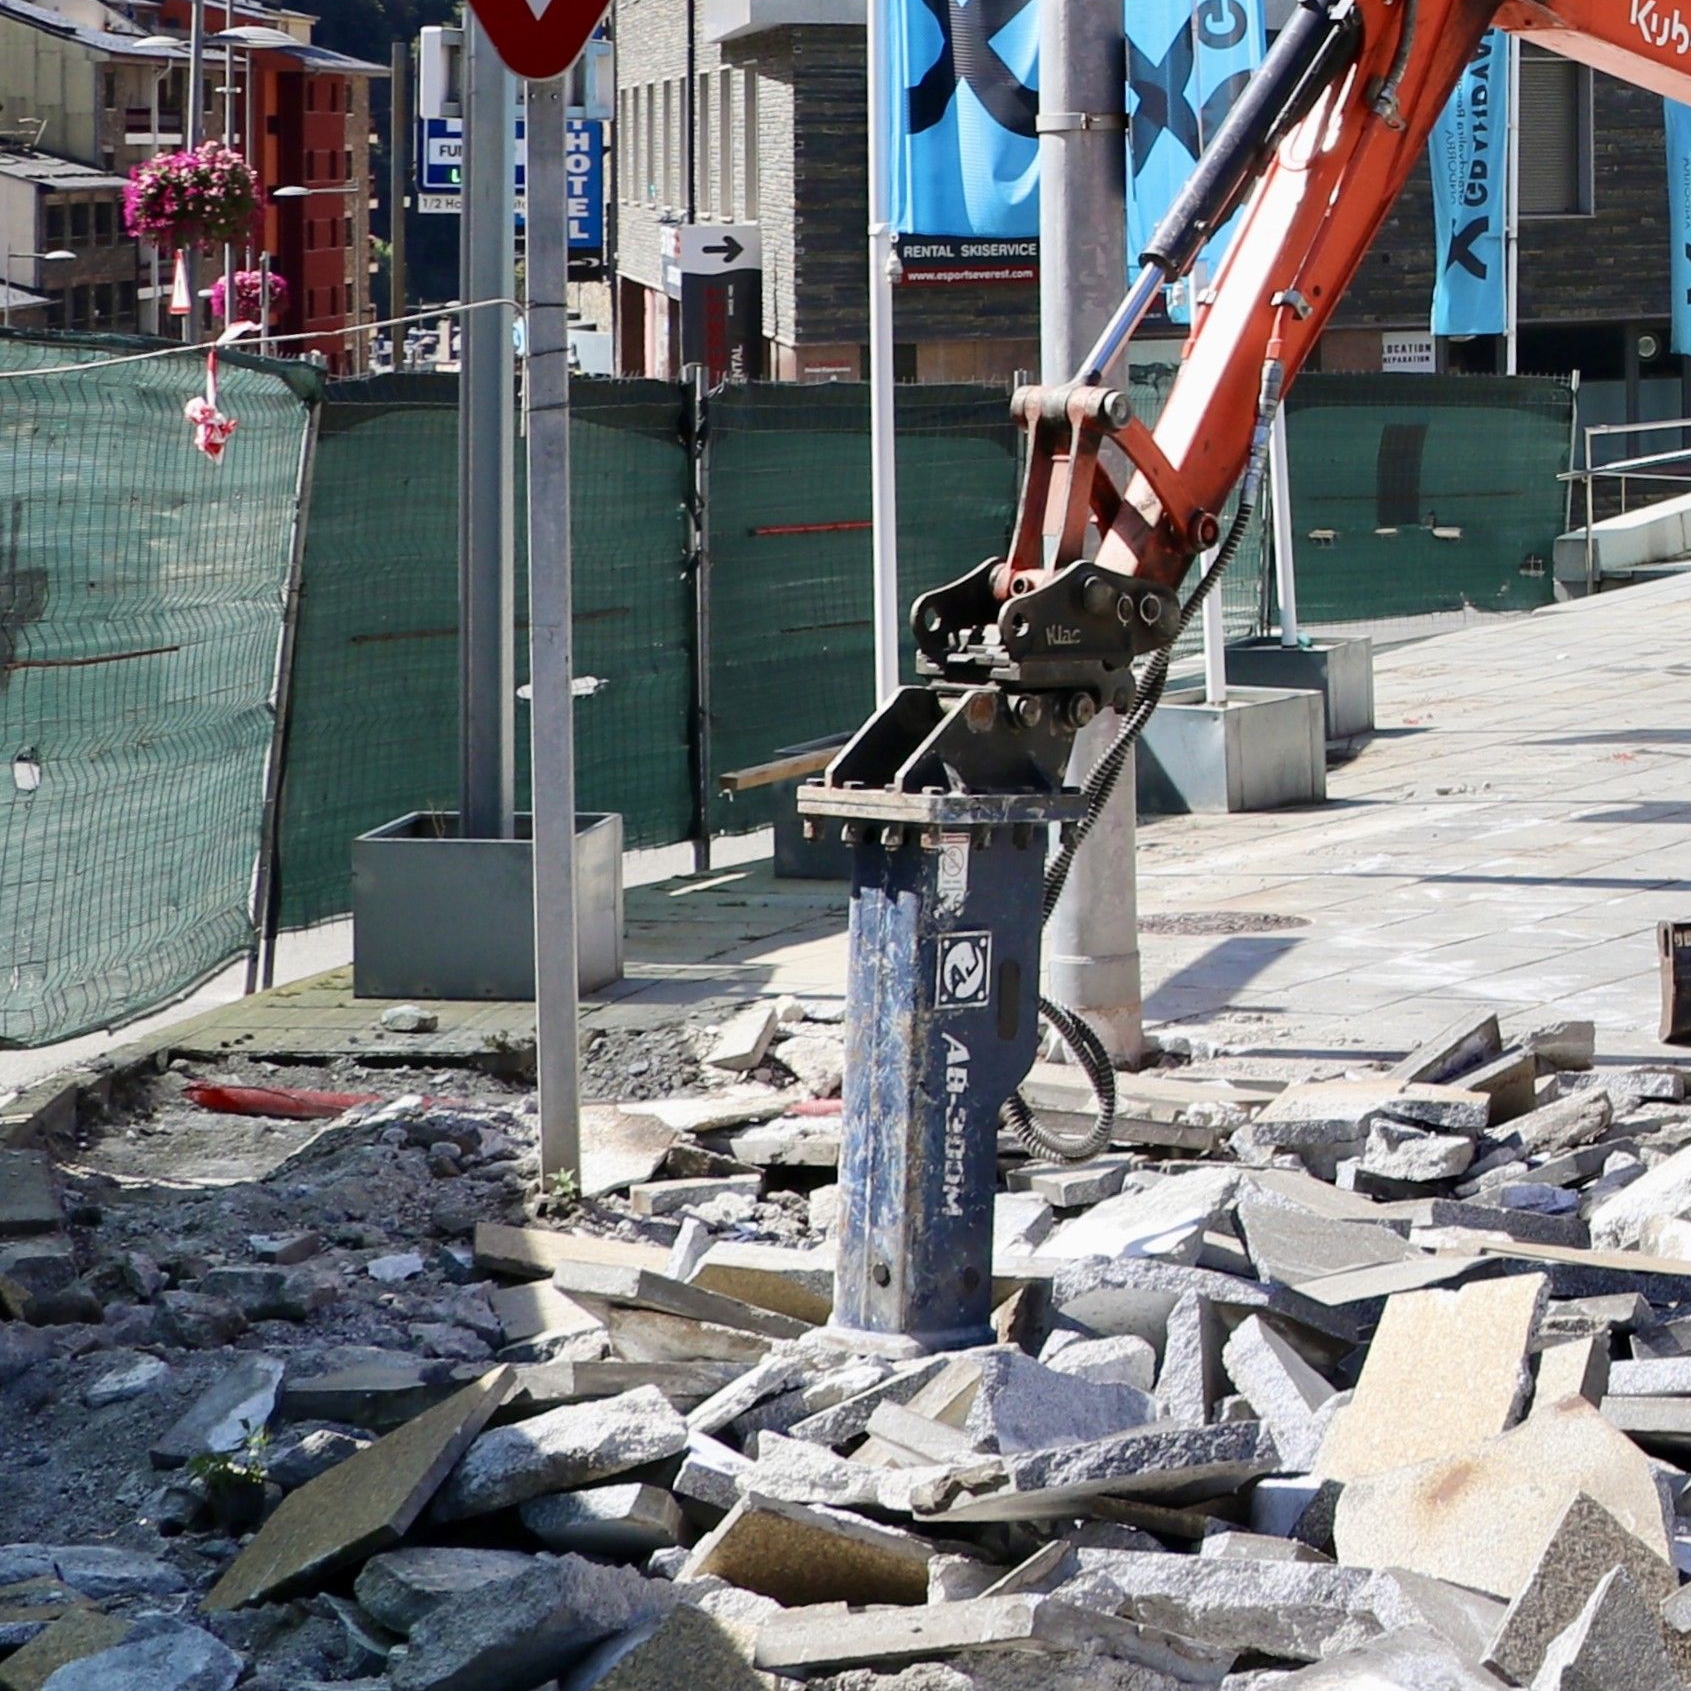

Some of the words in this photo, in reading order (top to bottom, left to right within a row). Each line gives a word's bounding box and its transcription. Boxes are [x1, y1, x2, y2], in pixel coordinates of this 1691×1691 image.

[423, 198, 441, 210] 1/2
[903, 244, 954, 258] RENTAL
[961, 243, 1038, 257] SKISERVICE
[907, 268, 1033, 282] www.esportseverest.com
